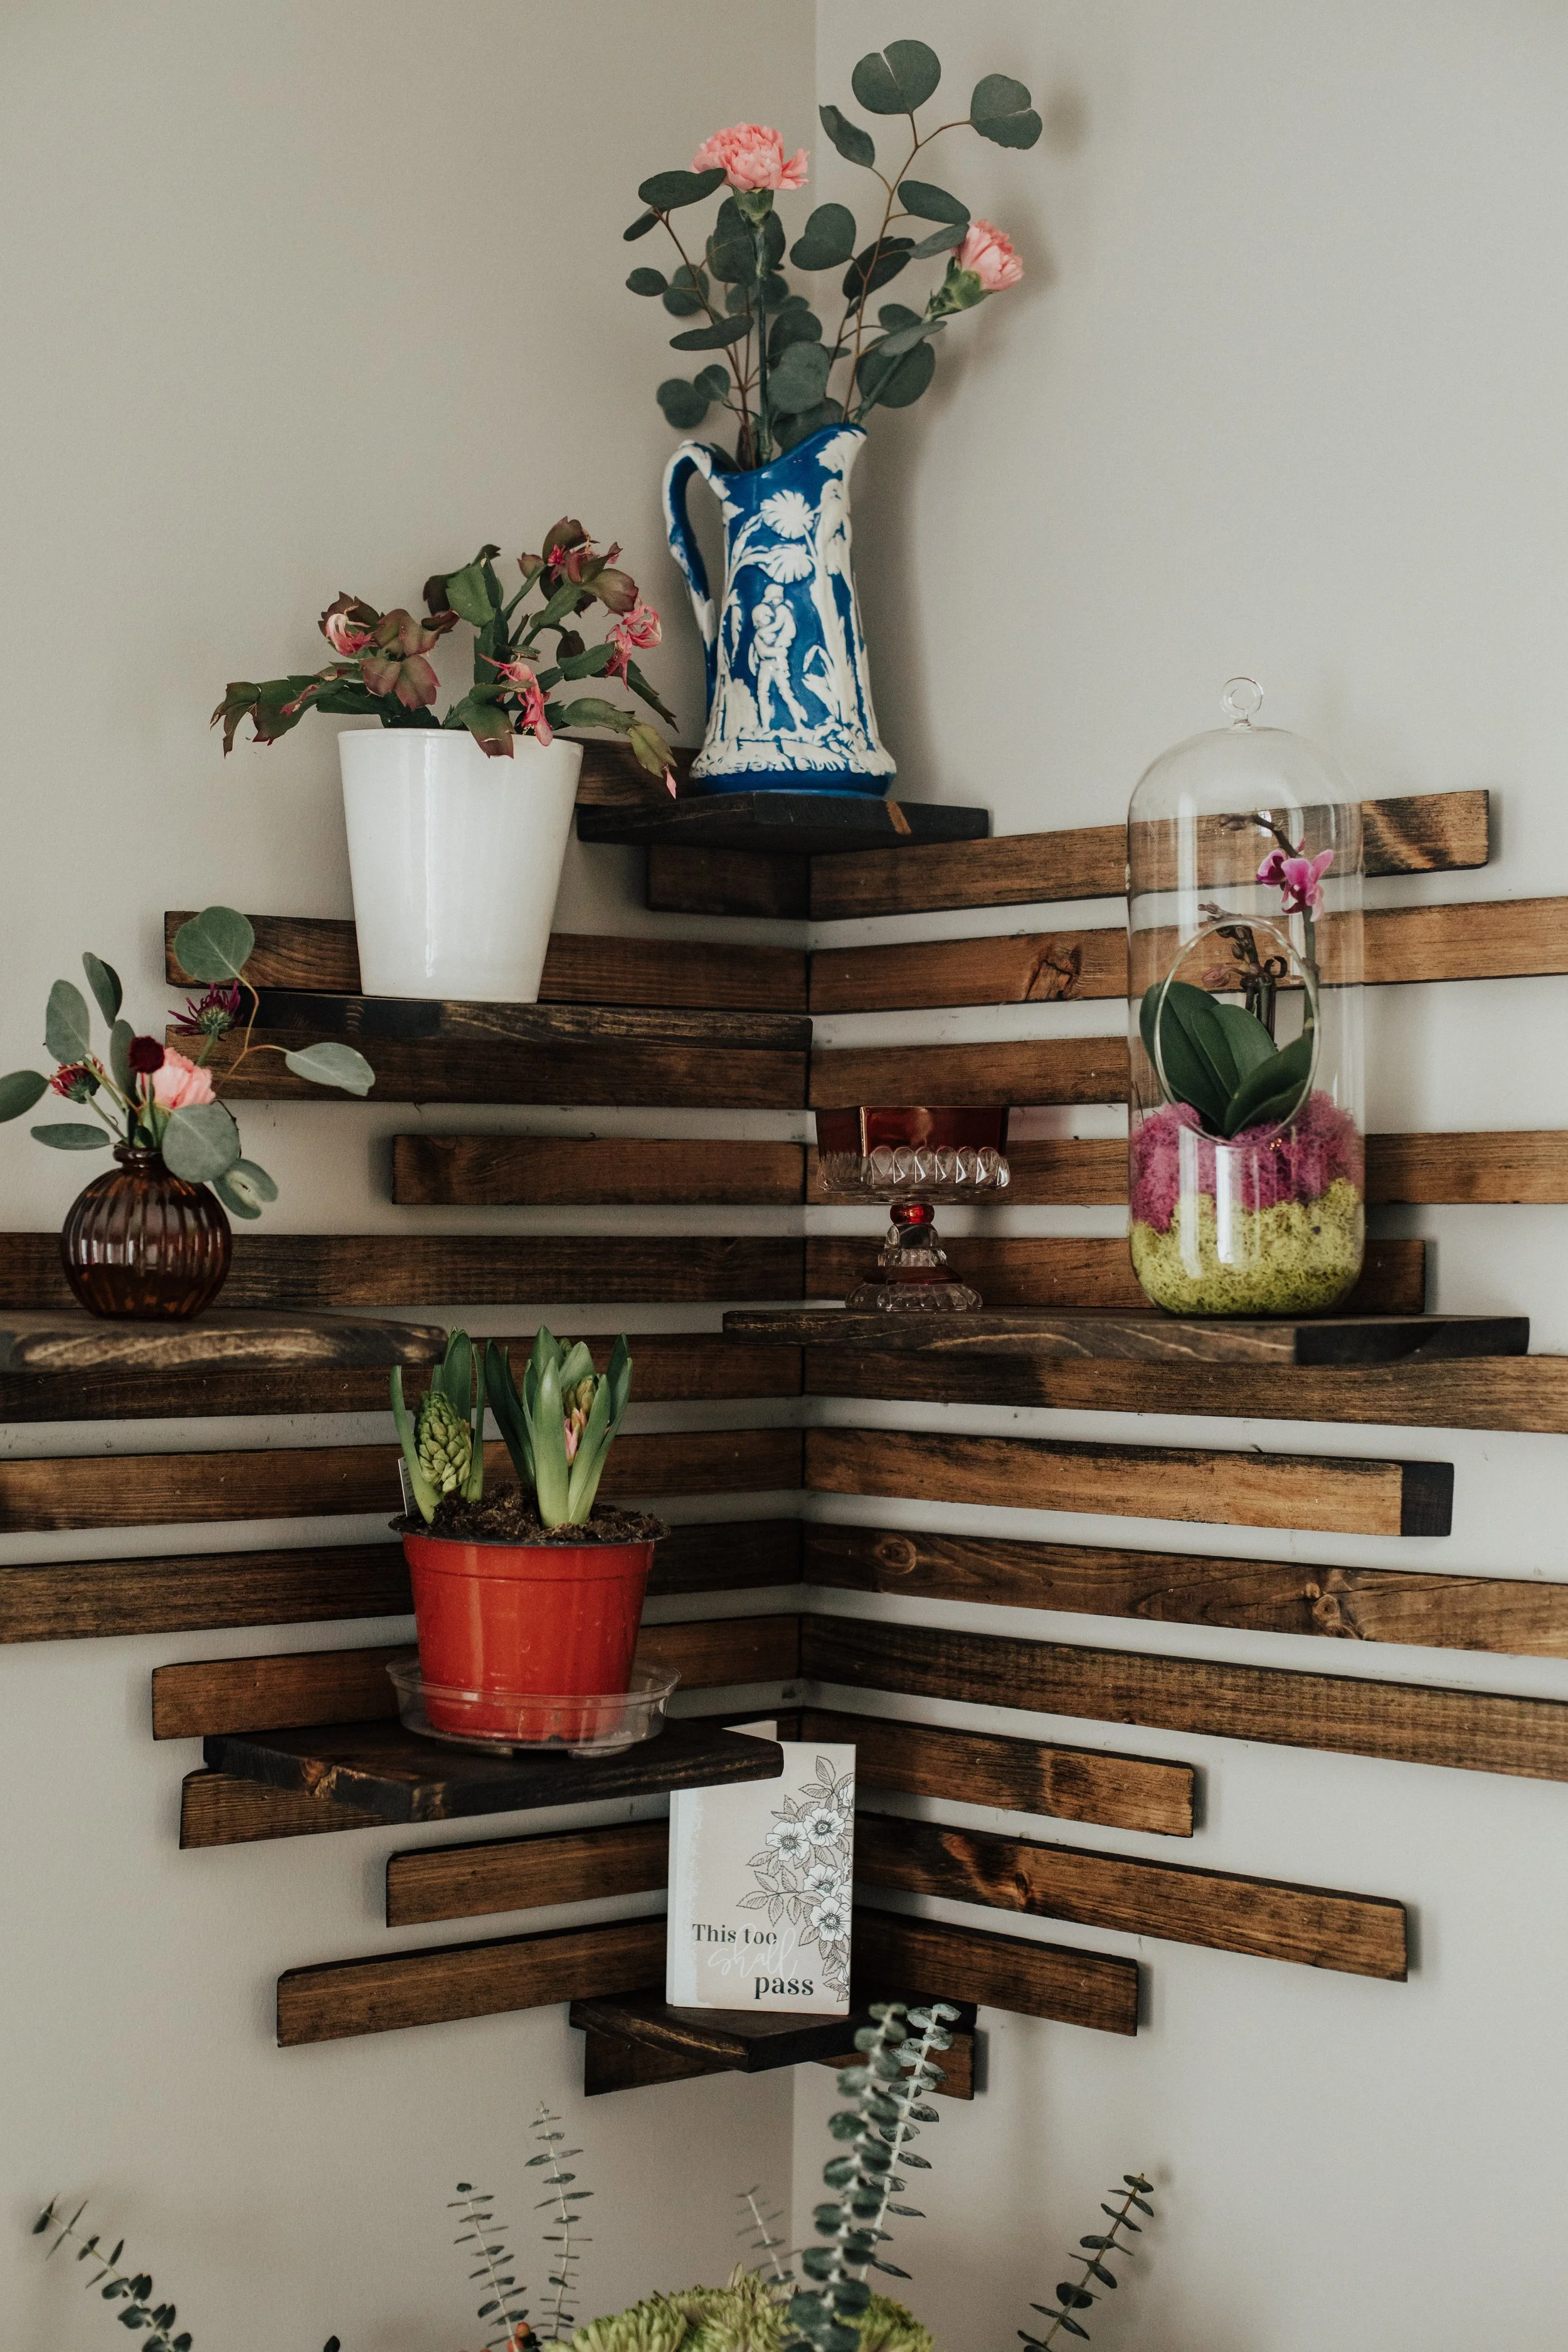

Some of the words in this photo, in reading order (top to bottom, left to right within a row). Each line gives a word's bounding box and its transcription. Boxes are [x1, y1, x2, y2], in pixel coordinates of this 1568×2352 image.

[692, 1924, 736, 1943] This
[743, 1928, 778, 1945] too
[707, 1923, 798, 1982] shall
[754, 1976, 814, 2000] pass
